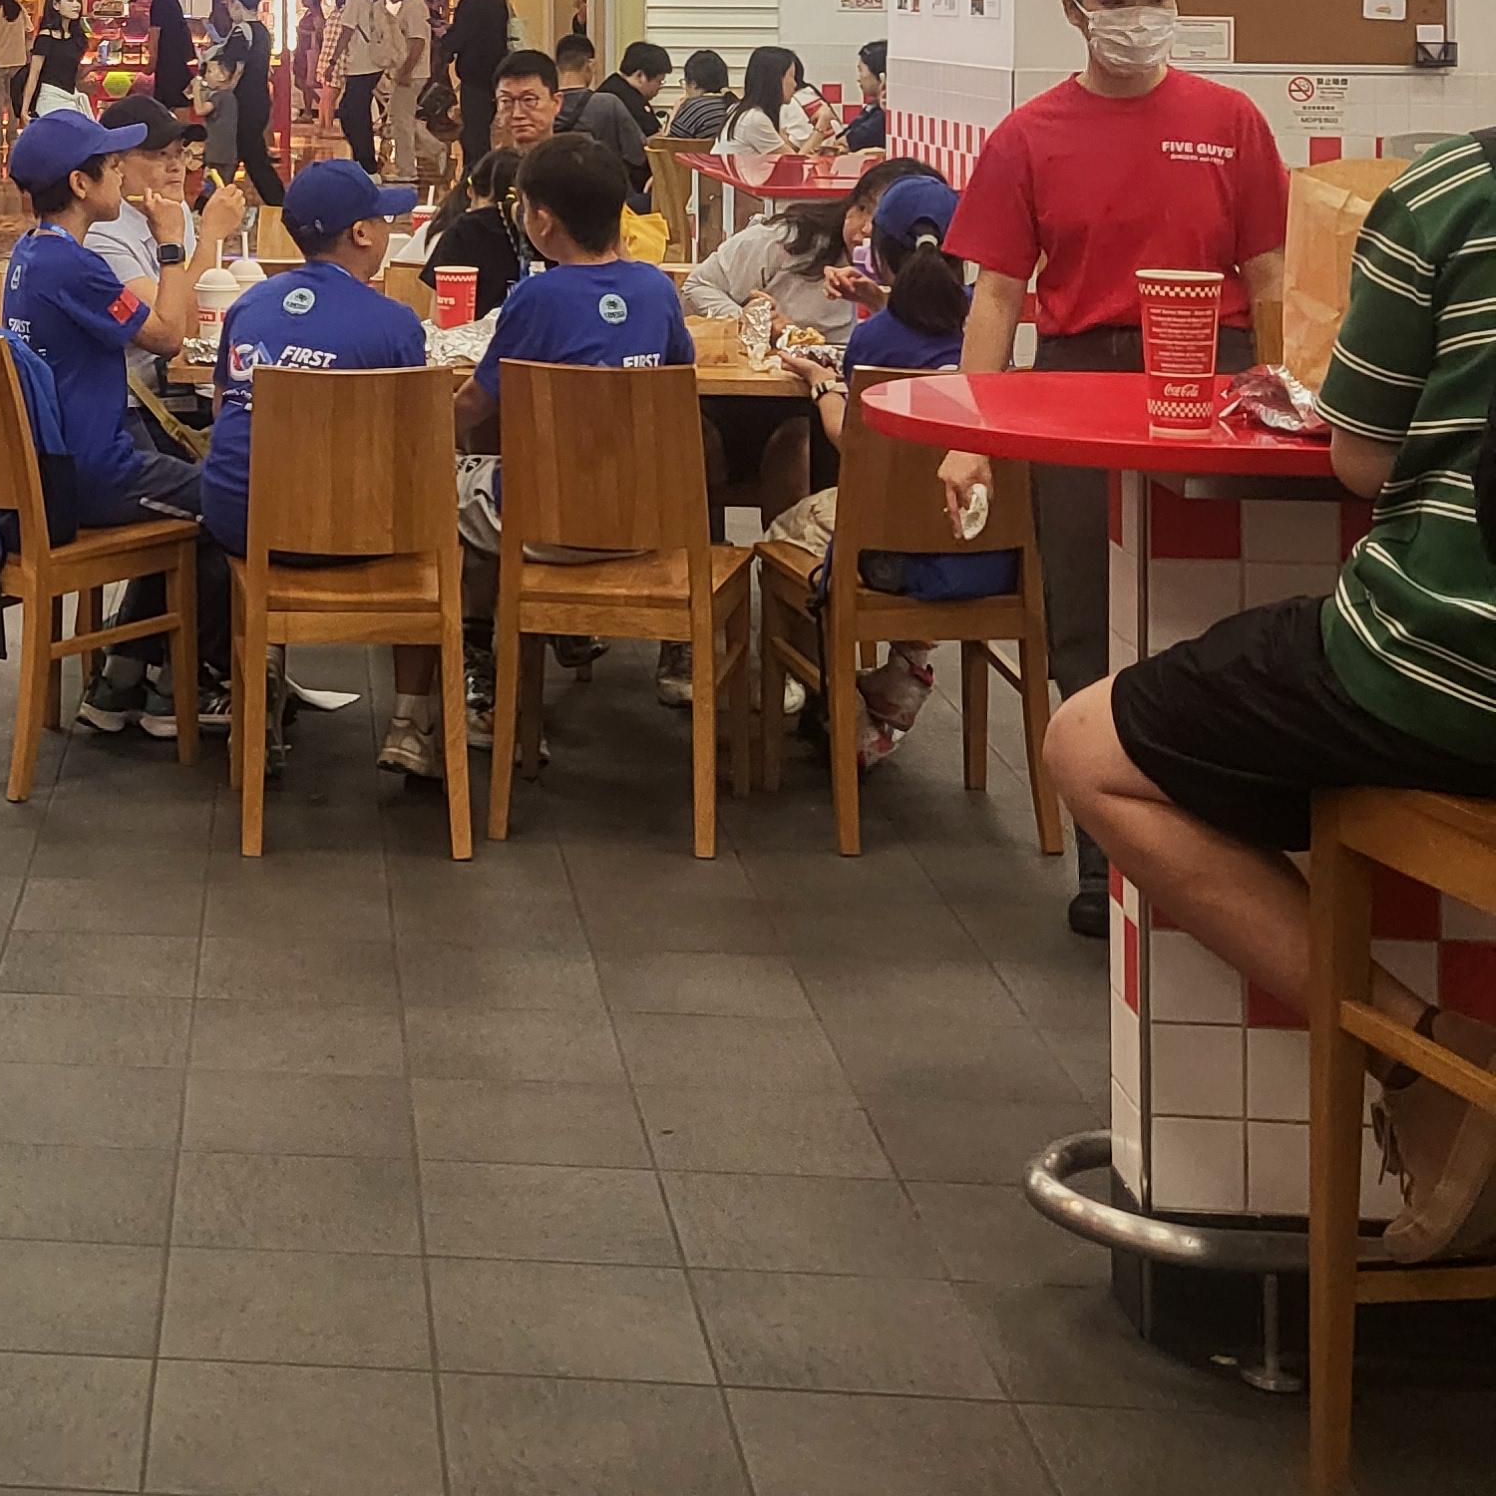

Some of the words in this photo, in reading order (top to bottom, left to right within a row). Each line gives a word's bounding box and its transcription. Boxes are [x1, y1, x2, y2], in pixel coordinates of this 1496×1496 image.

[1162, 141, 1194, 153] FIVE
[1196, 142, 1234, 159] GUYS
[279, 345, 337, 368] FIRST
[623, 353, 661, 368] FIRST
